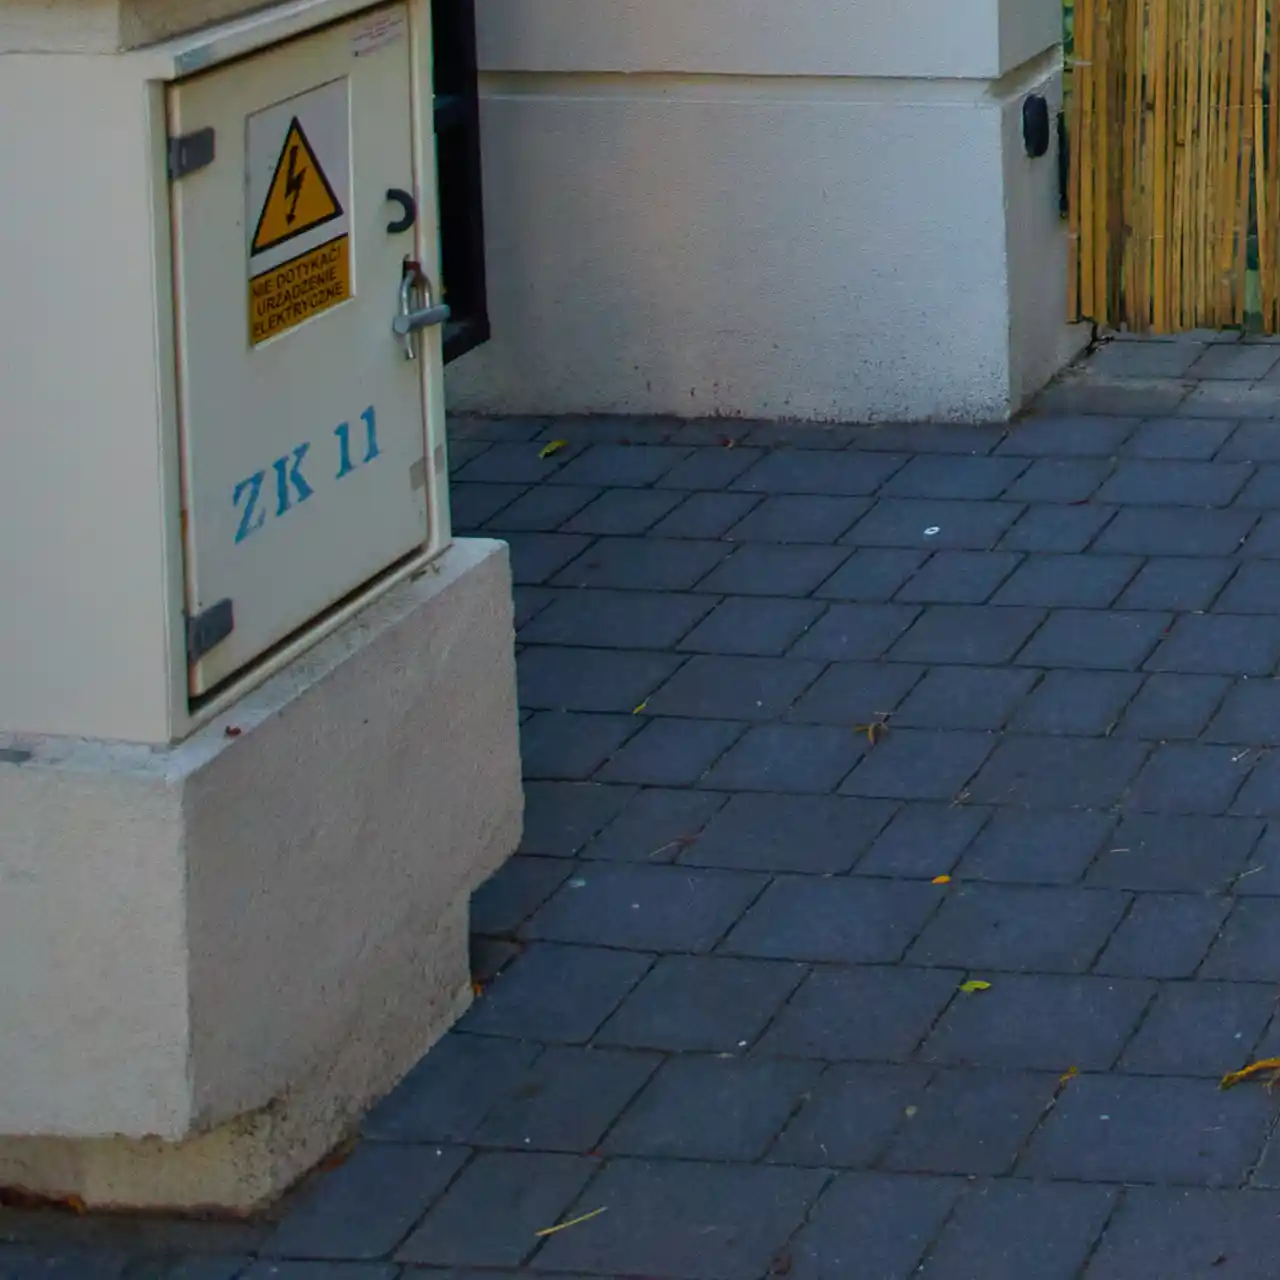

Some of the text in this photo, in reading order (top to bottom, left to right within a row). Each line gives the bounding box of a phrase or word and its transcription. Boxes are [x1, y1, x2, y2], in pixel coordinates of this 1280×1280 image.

[252, 280, 343, 338] ELEKTRYCZNE
[233, 405, 381, 544] ZK 11
